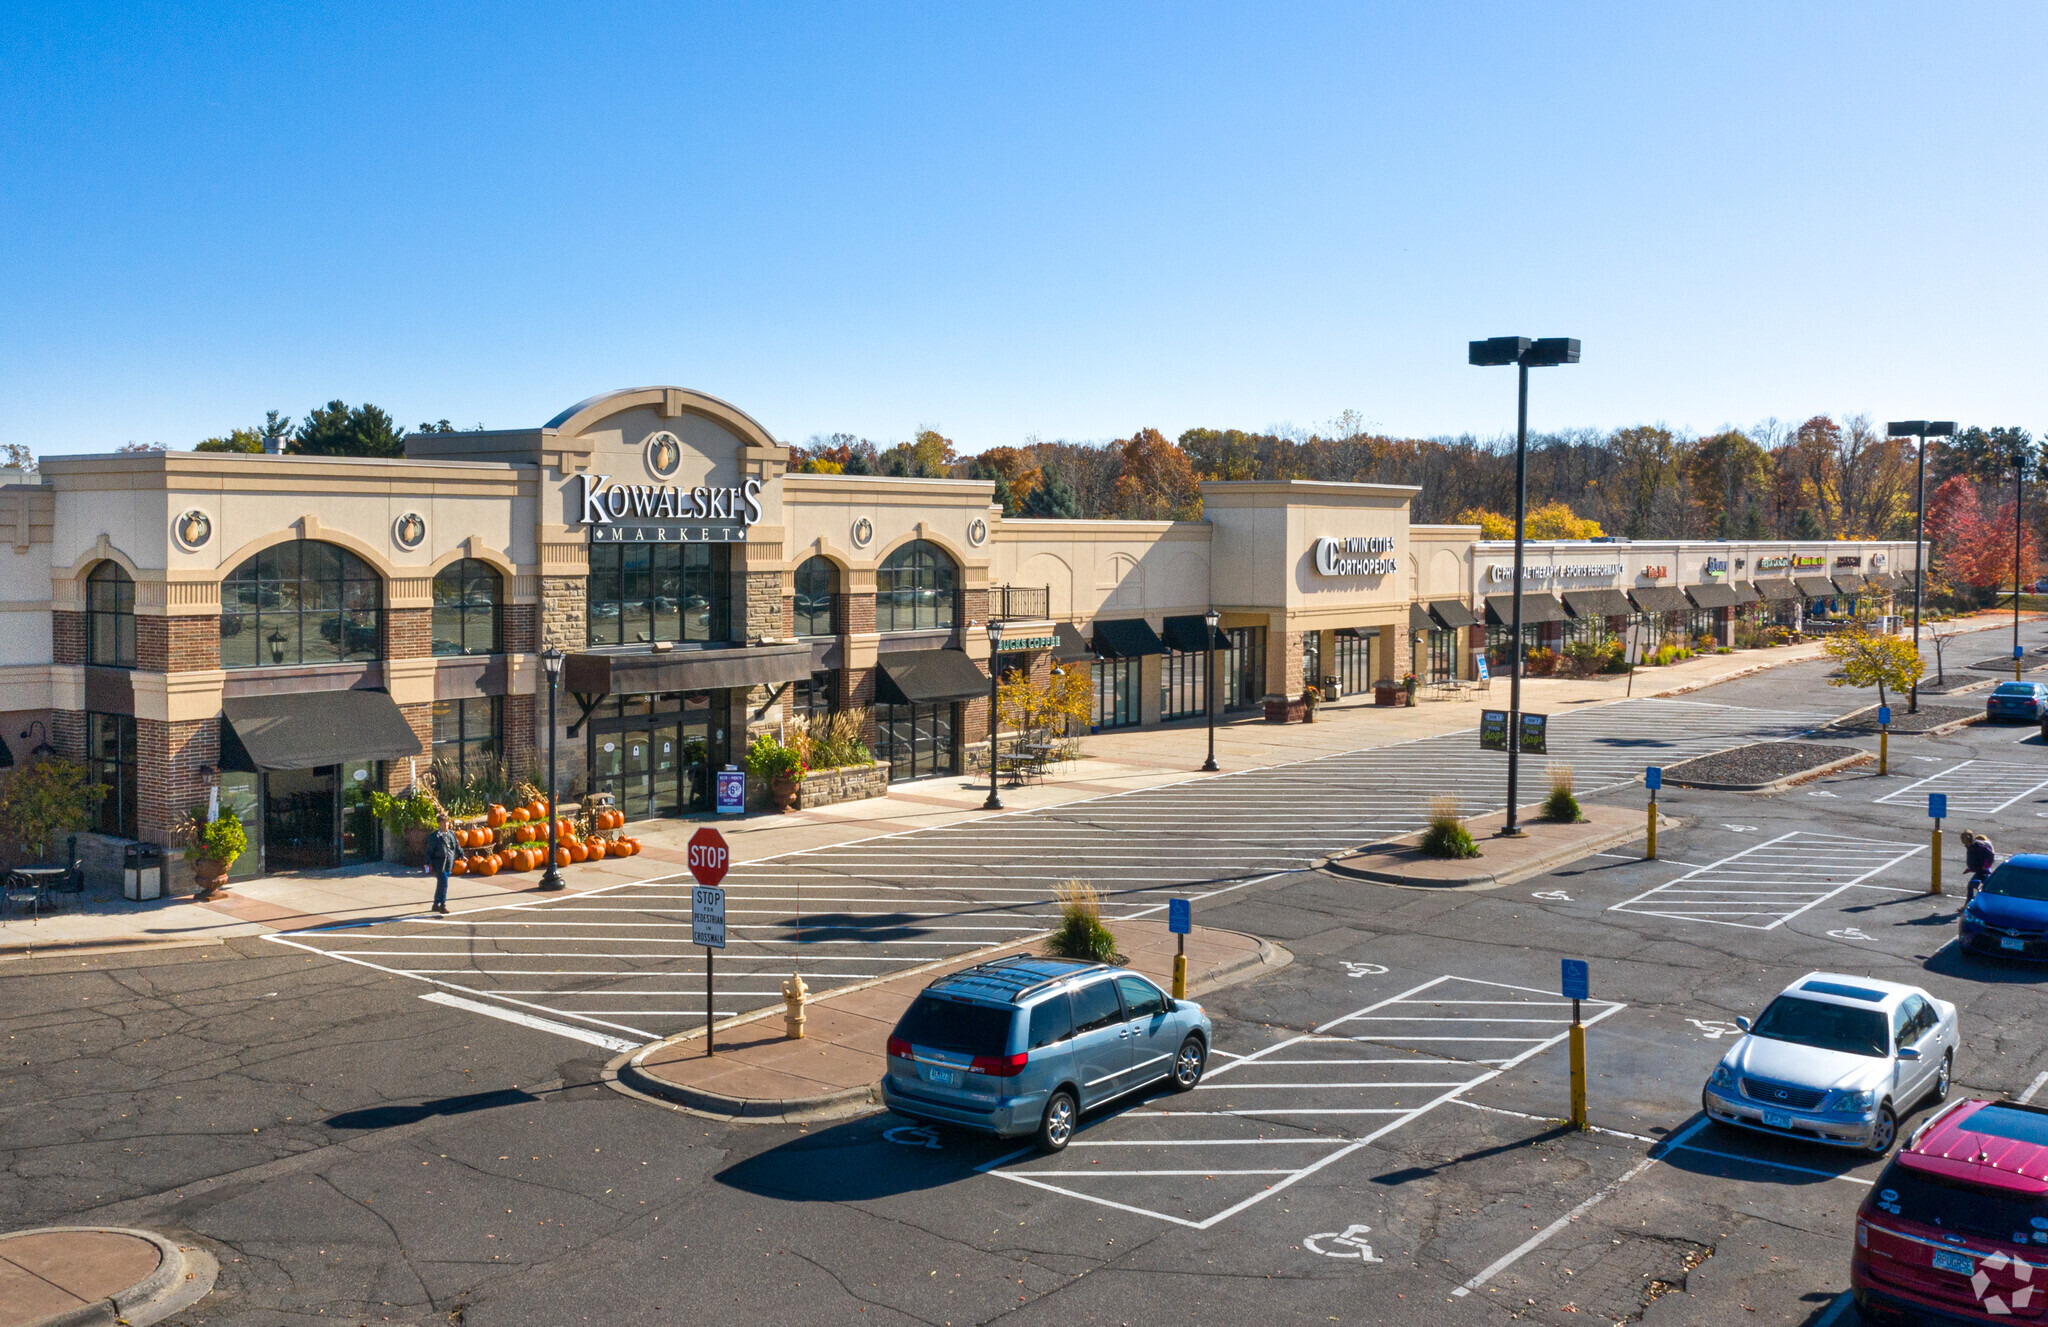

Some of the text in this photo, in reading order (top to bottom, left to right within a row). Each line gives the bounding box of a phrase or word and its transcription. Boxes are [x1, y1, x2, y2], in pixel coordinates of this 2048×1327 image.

[578, 474, 762, 525] KOWALSKI'S
[612, 528, 731, 541] MARKET
[1344, 537, 1395, 553] TWIN CITIES
[1339, 558, 1398, 576] ORTHOPEDICS
[1502, 563, 1625, 578] PHYAL THERAPY & SPORTS PERFORMANCE
[997, 635, 1060, 650] BUCKS COFFEE
[690, 845, 727, 868] STOP
[696, 890, 720, 905] STOP
[694, 912, 723, 925] PEDESTRIAN
[694, 931, 724, 944] CROSSWALK
